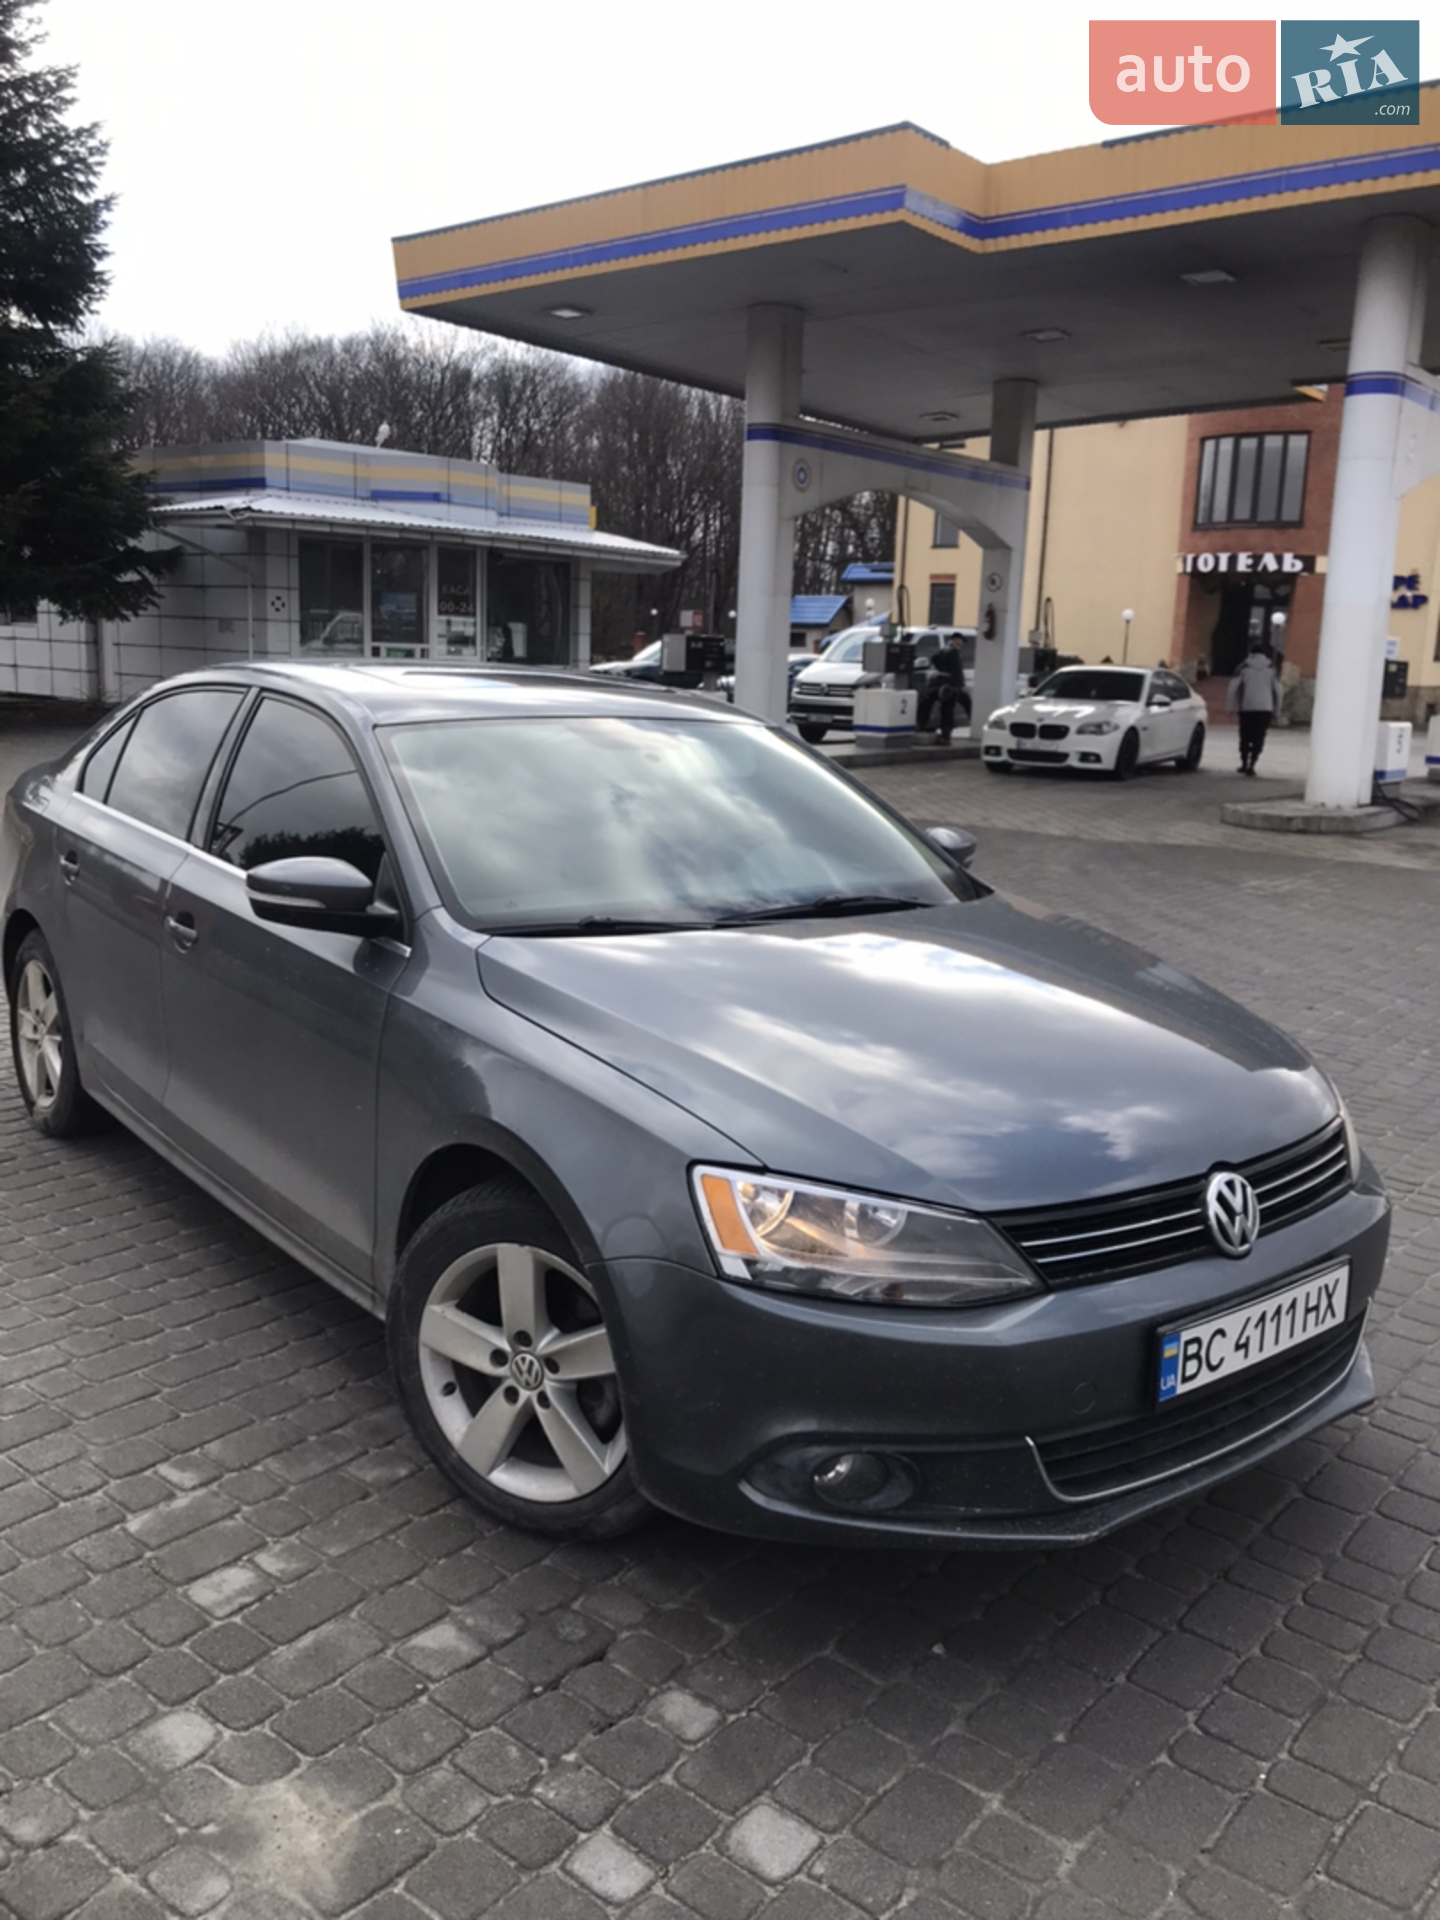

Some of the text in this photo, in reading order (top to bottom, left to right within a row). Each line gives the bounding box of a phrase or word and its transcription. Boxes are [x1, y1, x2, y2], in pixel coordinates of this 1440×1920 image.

[1183, 551, 1305, 574] ГОТЕЛЬ
[899, 697, 908, 716] 2
[1180, 1277, 1341, 1386] BC 4111 HX
[1160, 1373, 1177, 1391] UA
